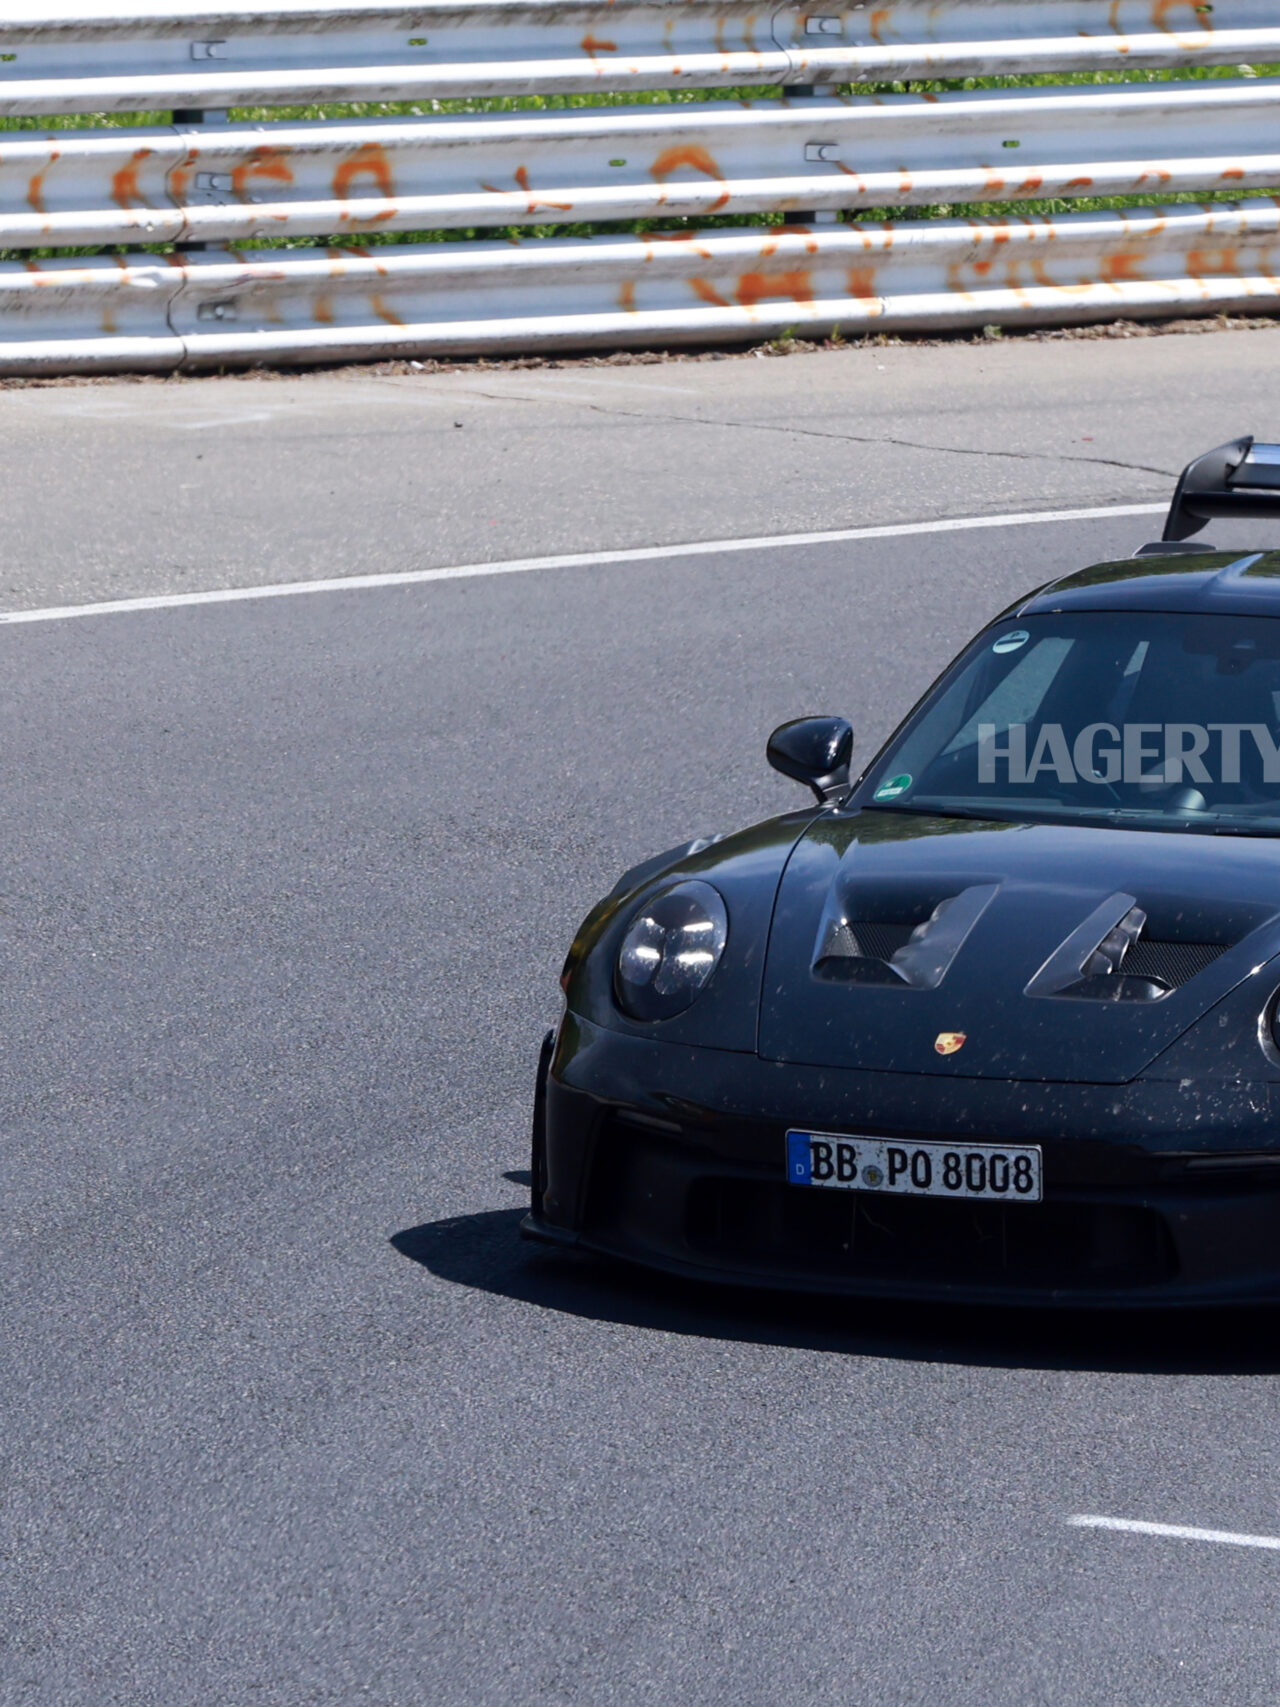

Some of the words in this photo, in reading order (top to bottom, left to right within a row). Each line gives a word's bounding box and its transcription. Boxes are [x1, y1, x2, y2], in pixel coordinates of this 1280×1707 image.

[795, 1163, 805, 1176] D
[810, 1141, 858, 1182] BB
[887, 1147, 932, 1188] PO
[943, 1152, 1034, 1194] 8008
